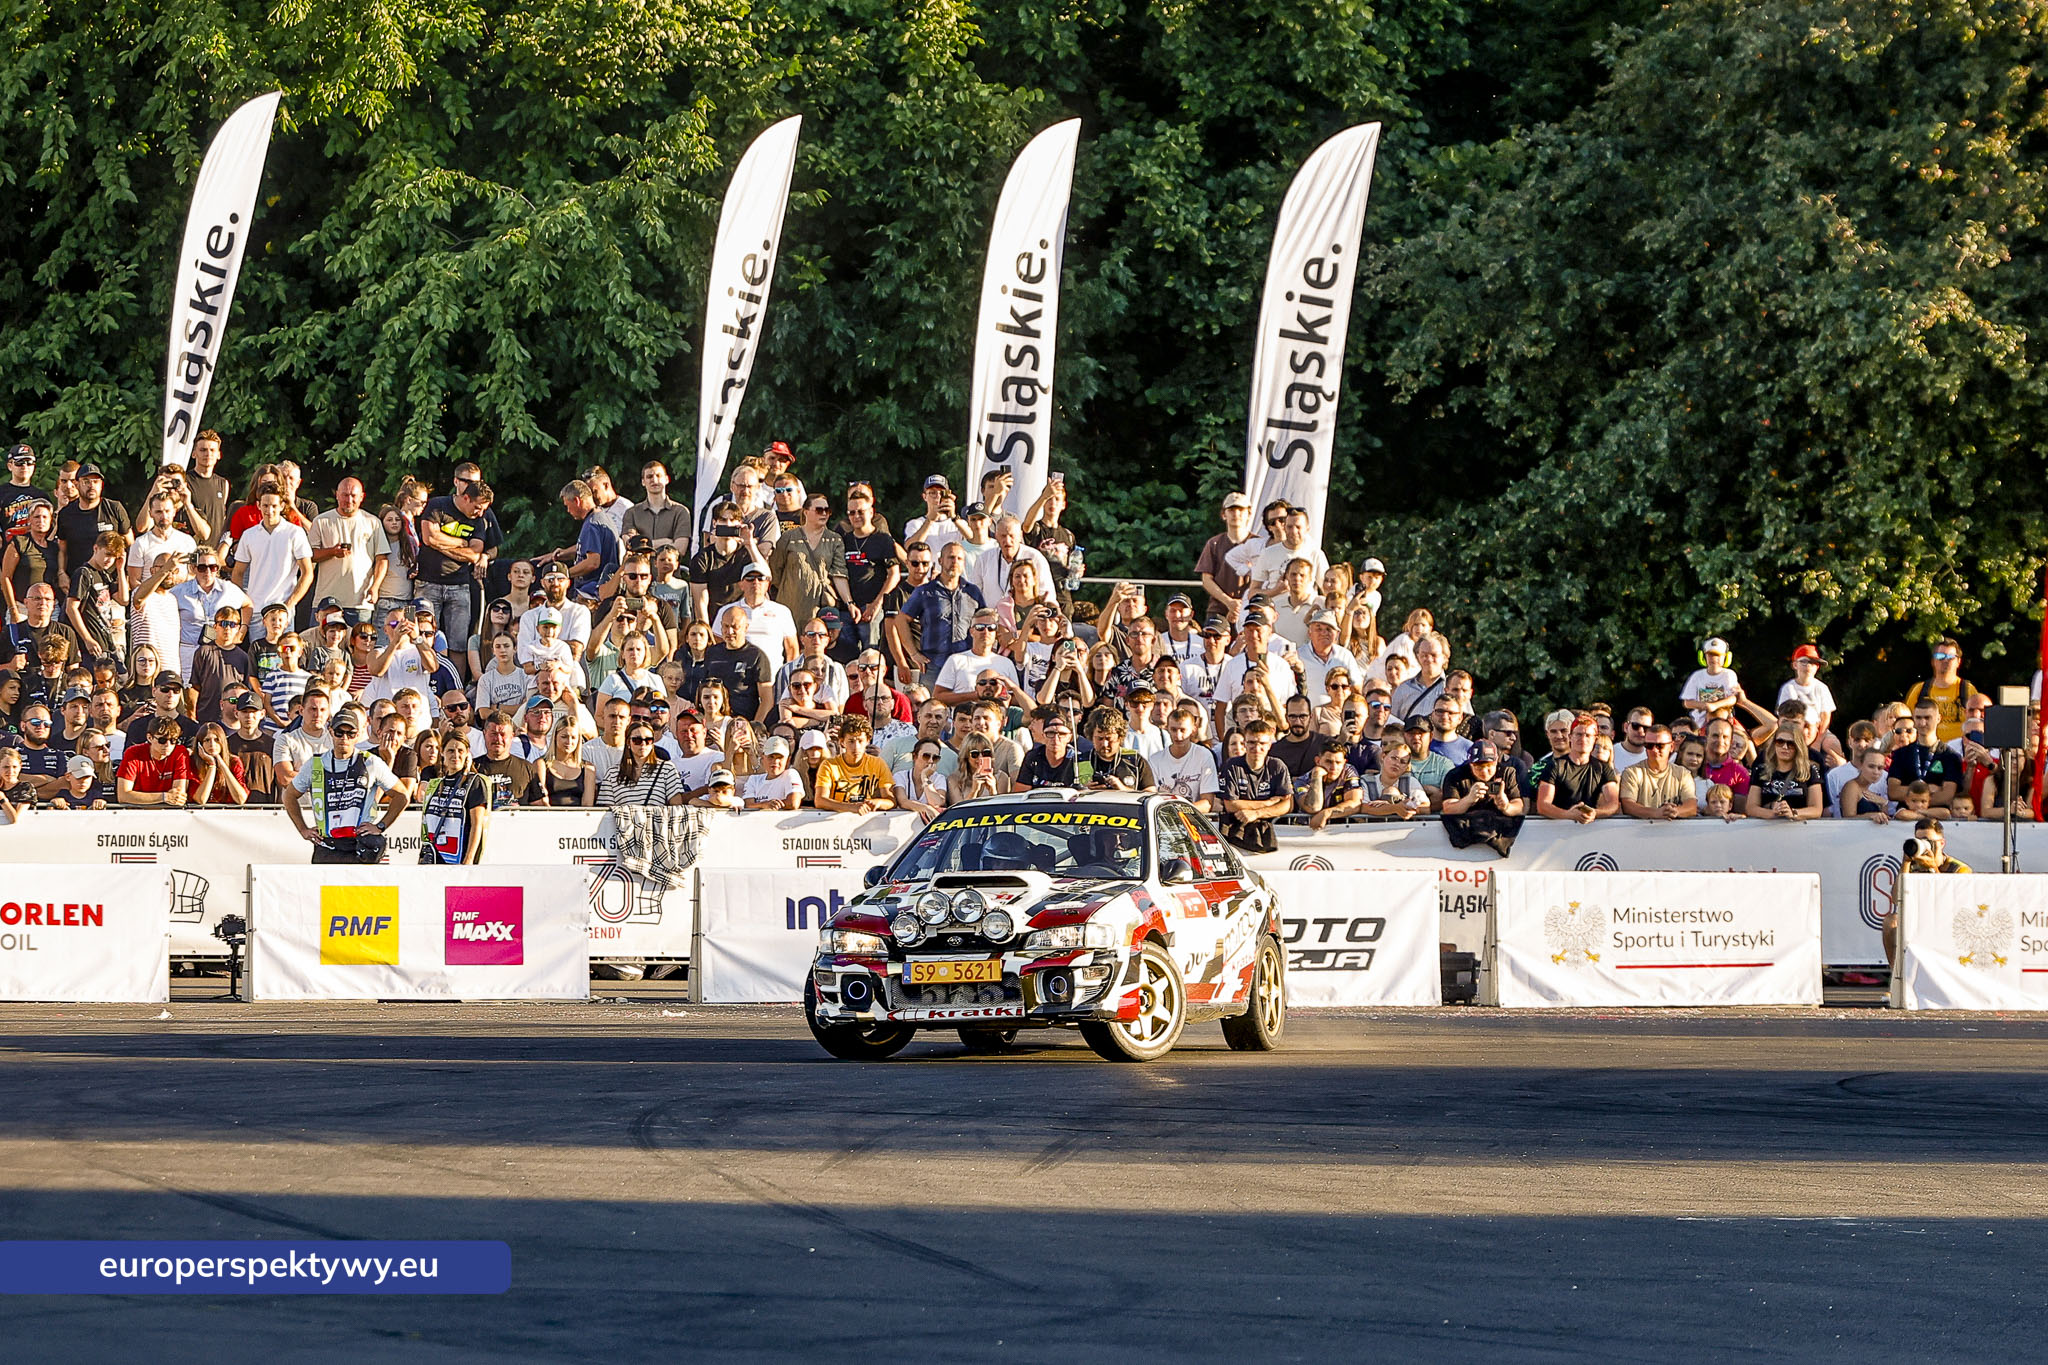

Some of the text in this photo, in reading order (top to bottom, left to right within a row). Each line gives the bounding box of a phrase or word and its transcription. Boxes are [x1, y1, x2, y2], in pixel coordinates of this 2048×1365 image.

[976, 238, 1050, 466] Śląskie.
[1257, 243, 1343, 474] Śląskie.
[928, 812, 1143, 833] RALLY CONTROL
[97, 832, 189, 851] STADION ŚLĄSKI
[385, 834, 421, 853] LĄSKI
[558, 837, 606, 850] STADION
[782, 836, 873, 854] STADION ŚLĄSKI
[0, 902, 104, 927] ORLEN
[1440, 890, 1488, 919] LĄSK
[452, 911, 480, 921] RMF
[1613, 907, 1734, 924] Ministerstwo
[329, 915, 392, 937] RMF
[1282, 917, 1386, 943] OTO
[1, 933, 38, 951] OIL
[1613, 930, 1775, 951] Sportu i Turystyki
[2021, 935, 2048, 955] Spo
[914, 962, 994, 982] S9 5621
[928, 1006, 1024, 1019] kratki
